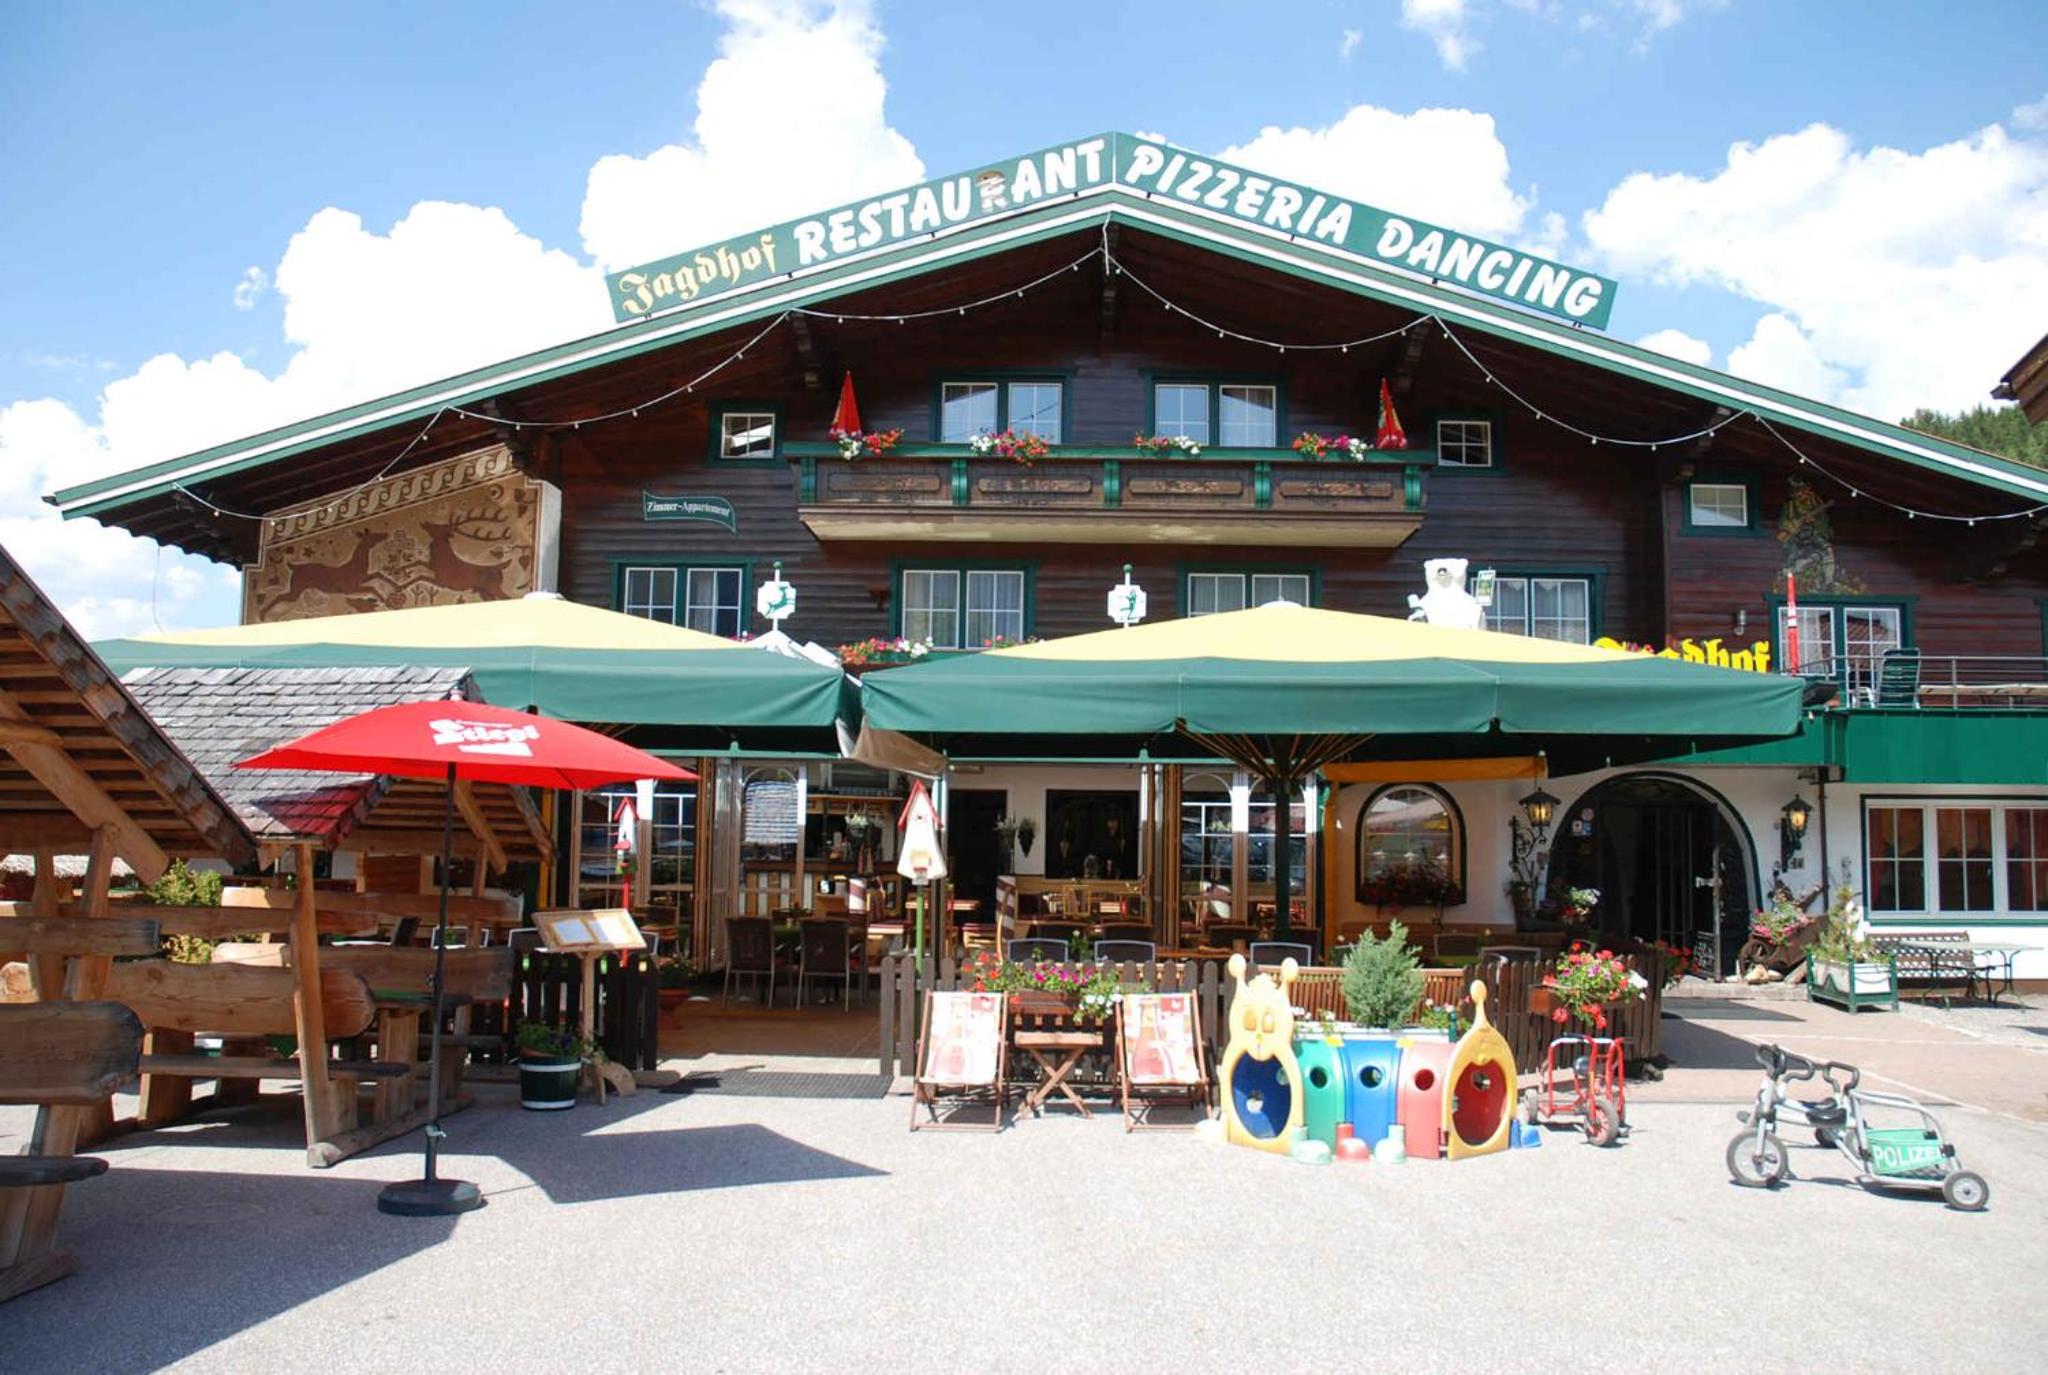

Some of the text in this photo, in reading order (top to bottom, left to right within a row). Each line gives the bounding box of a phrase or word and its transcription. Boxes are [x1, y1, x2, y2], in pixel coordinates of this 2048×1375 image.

[618, 138, 1106, 314] Jagdhof RESTAURANT
[1124, 144, 1604, 317] PIZZERIA DANCING
